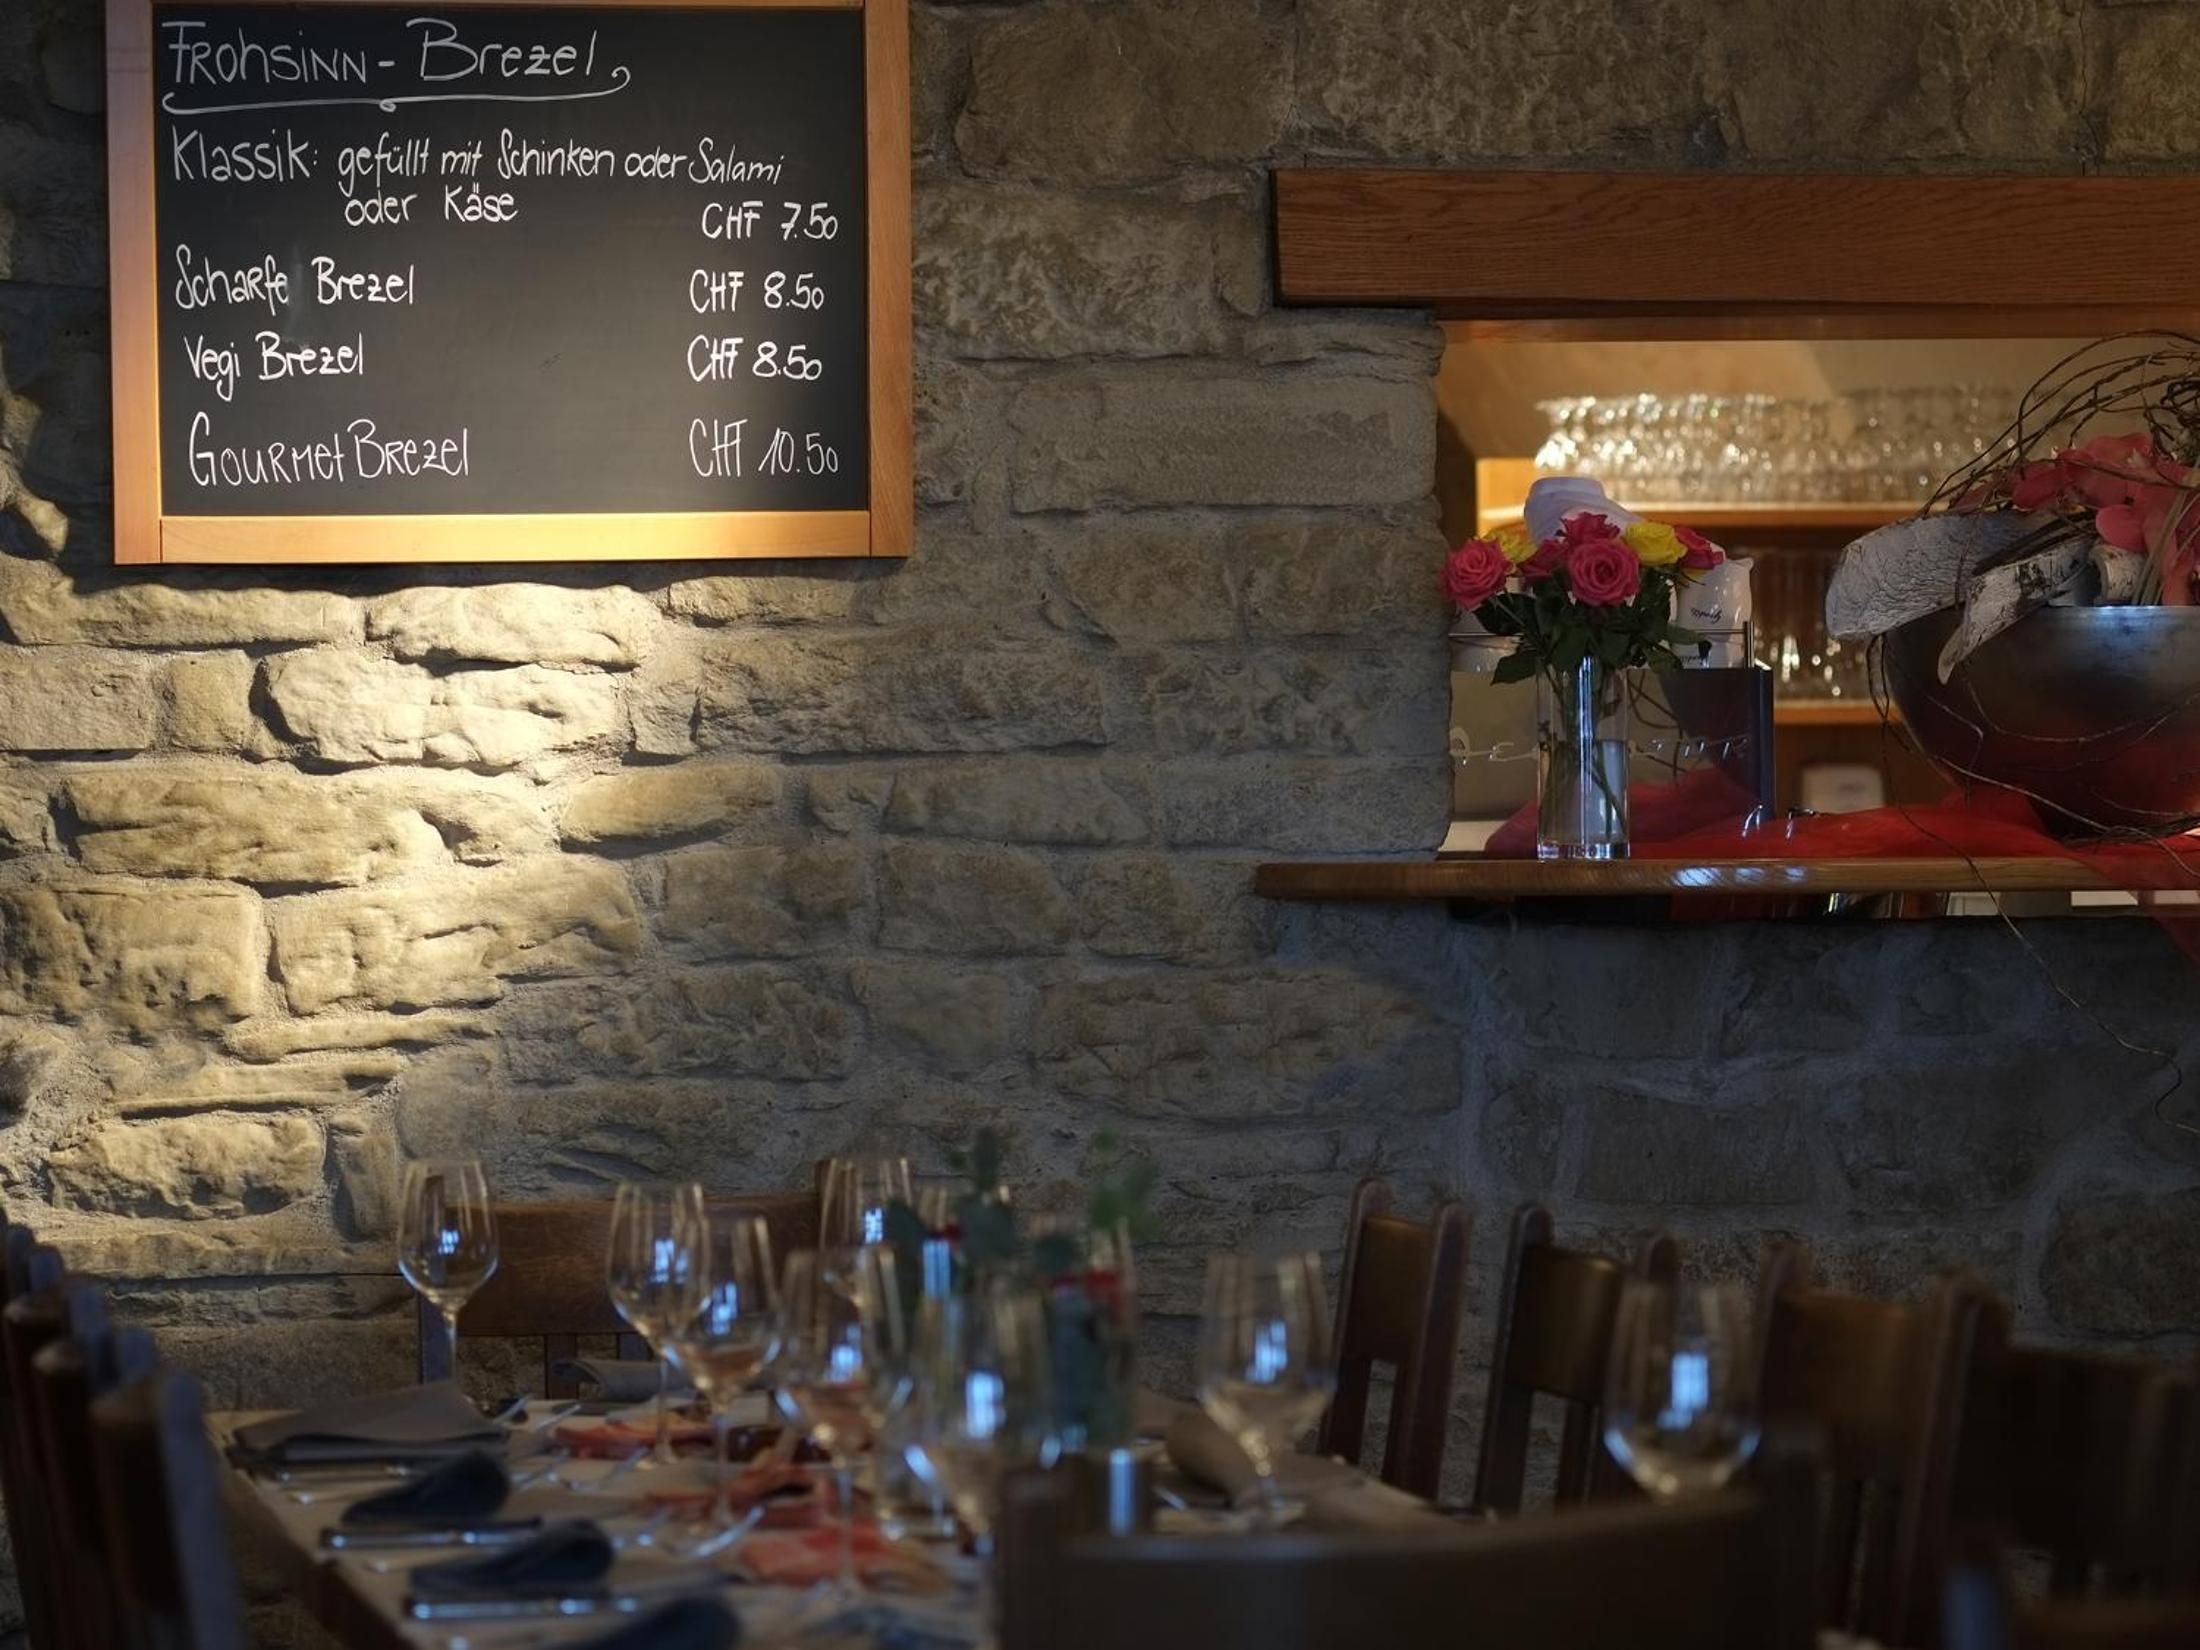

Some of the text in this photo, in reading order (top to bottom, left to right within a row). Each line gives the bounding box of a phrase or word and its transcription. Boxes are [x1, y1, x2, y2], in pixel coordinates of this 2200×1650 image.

[406, 18, 597, 81] Brezel
[338, 131, 429, 198] gefüllt
[441, 140, 483, 176] mit
[498, 128, 615, 179] Schinken
[625, 146, 686, 178] oder
[688, 137, 784, 184] Salami
[344, 182, 518, 226] oder Käse
[702, 201, 838, 240] CHF 7.50
[311, 256, 414, 305] Brezel
[690, 269, 824, 313] CHF 8.50
[184, 331, 363, 402] Vegi Brezel
[687, 334, 822, 382] CHF 8.50
[689, 418, 838, 477] CHF 10.50
